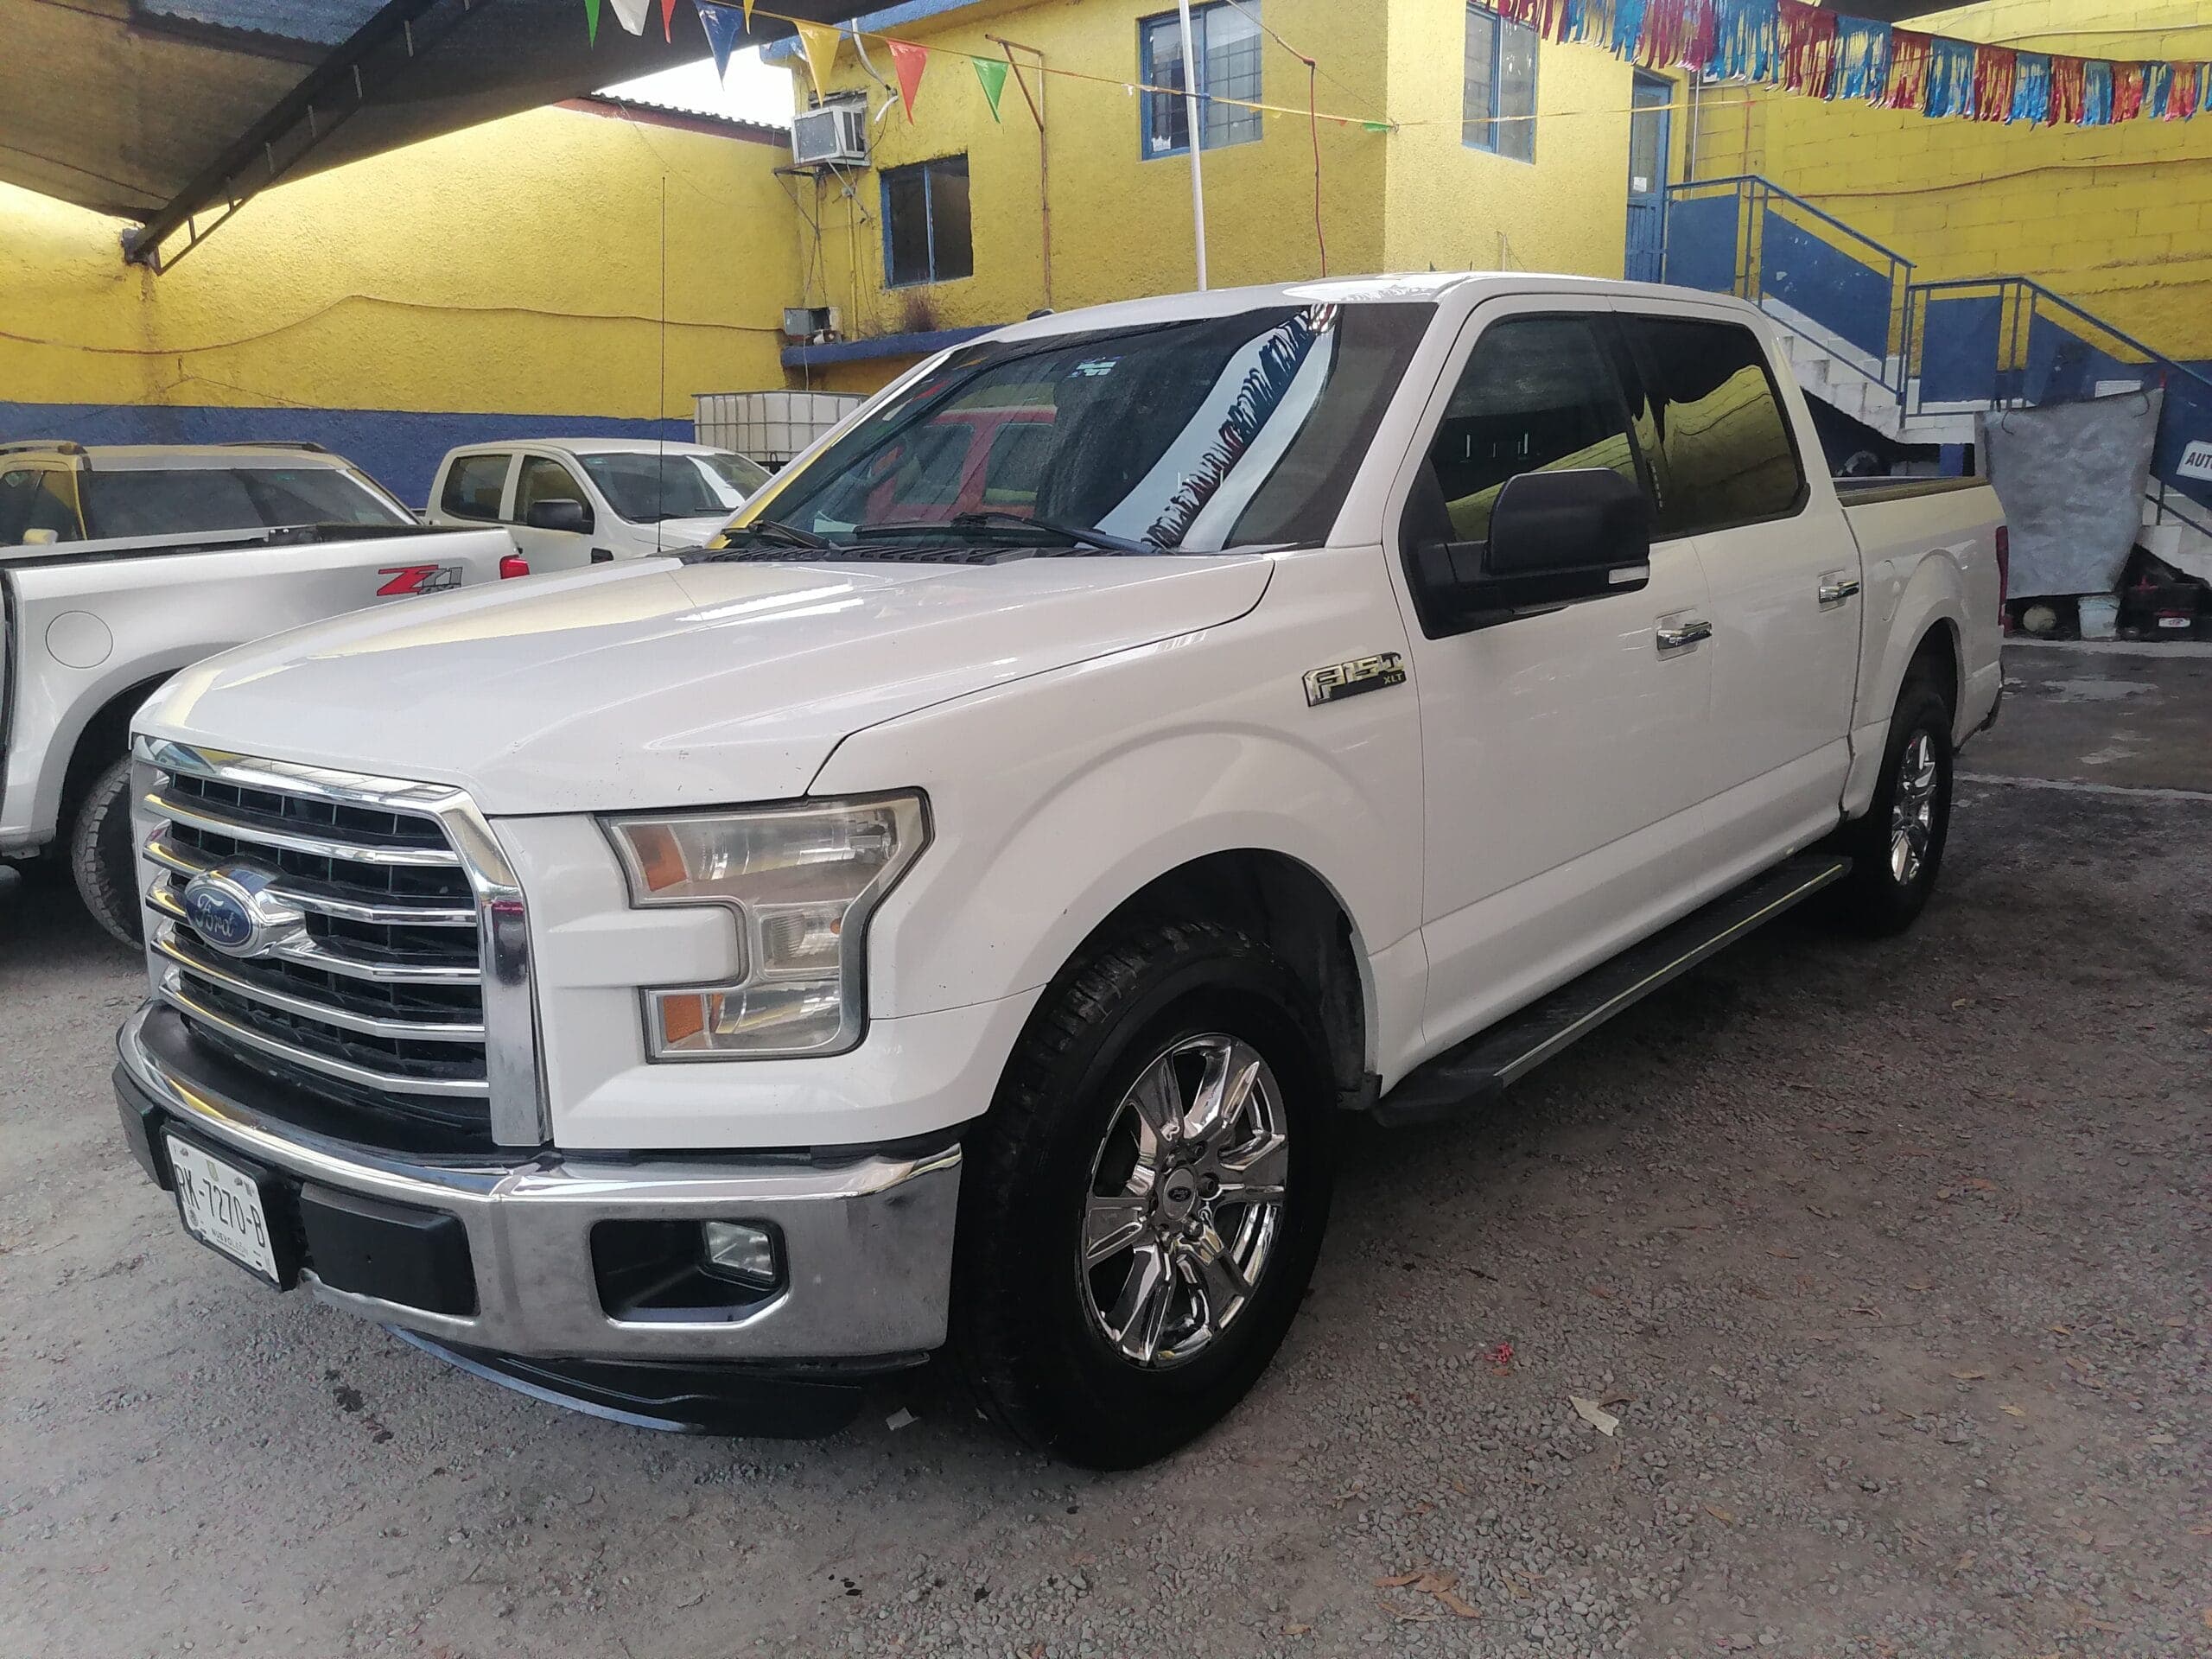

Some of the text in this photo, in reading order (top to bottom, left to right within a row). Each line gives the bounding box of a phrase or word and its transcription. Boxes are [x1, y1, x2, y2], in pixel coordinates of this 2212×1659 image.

[2185, 452, 2212, 469] AUT
[377, 564, 463, 596] Z71
[1383, 673, 1403, 684] XLT
[196, 893, 235, 938] Ford
[174, 1163, 265, 1248] RK-7270-B
